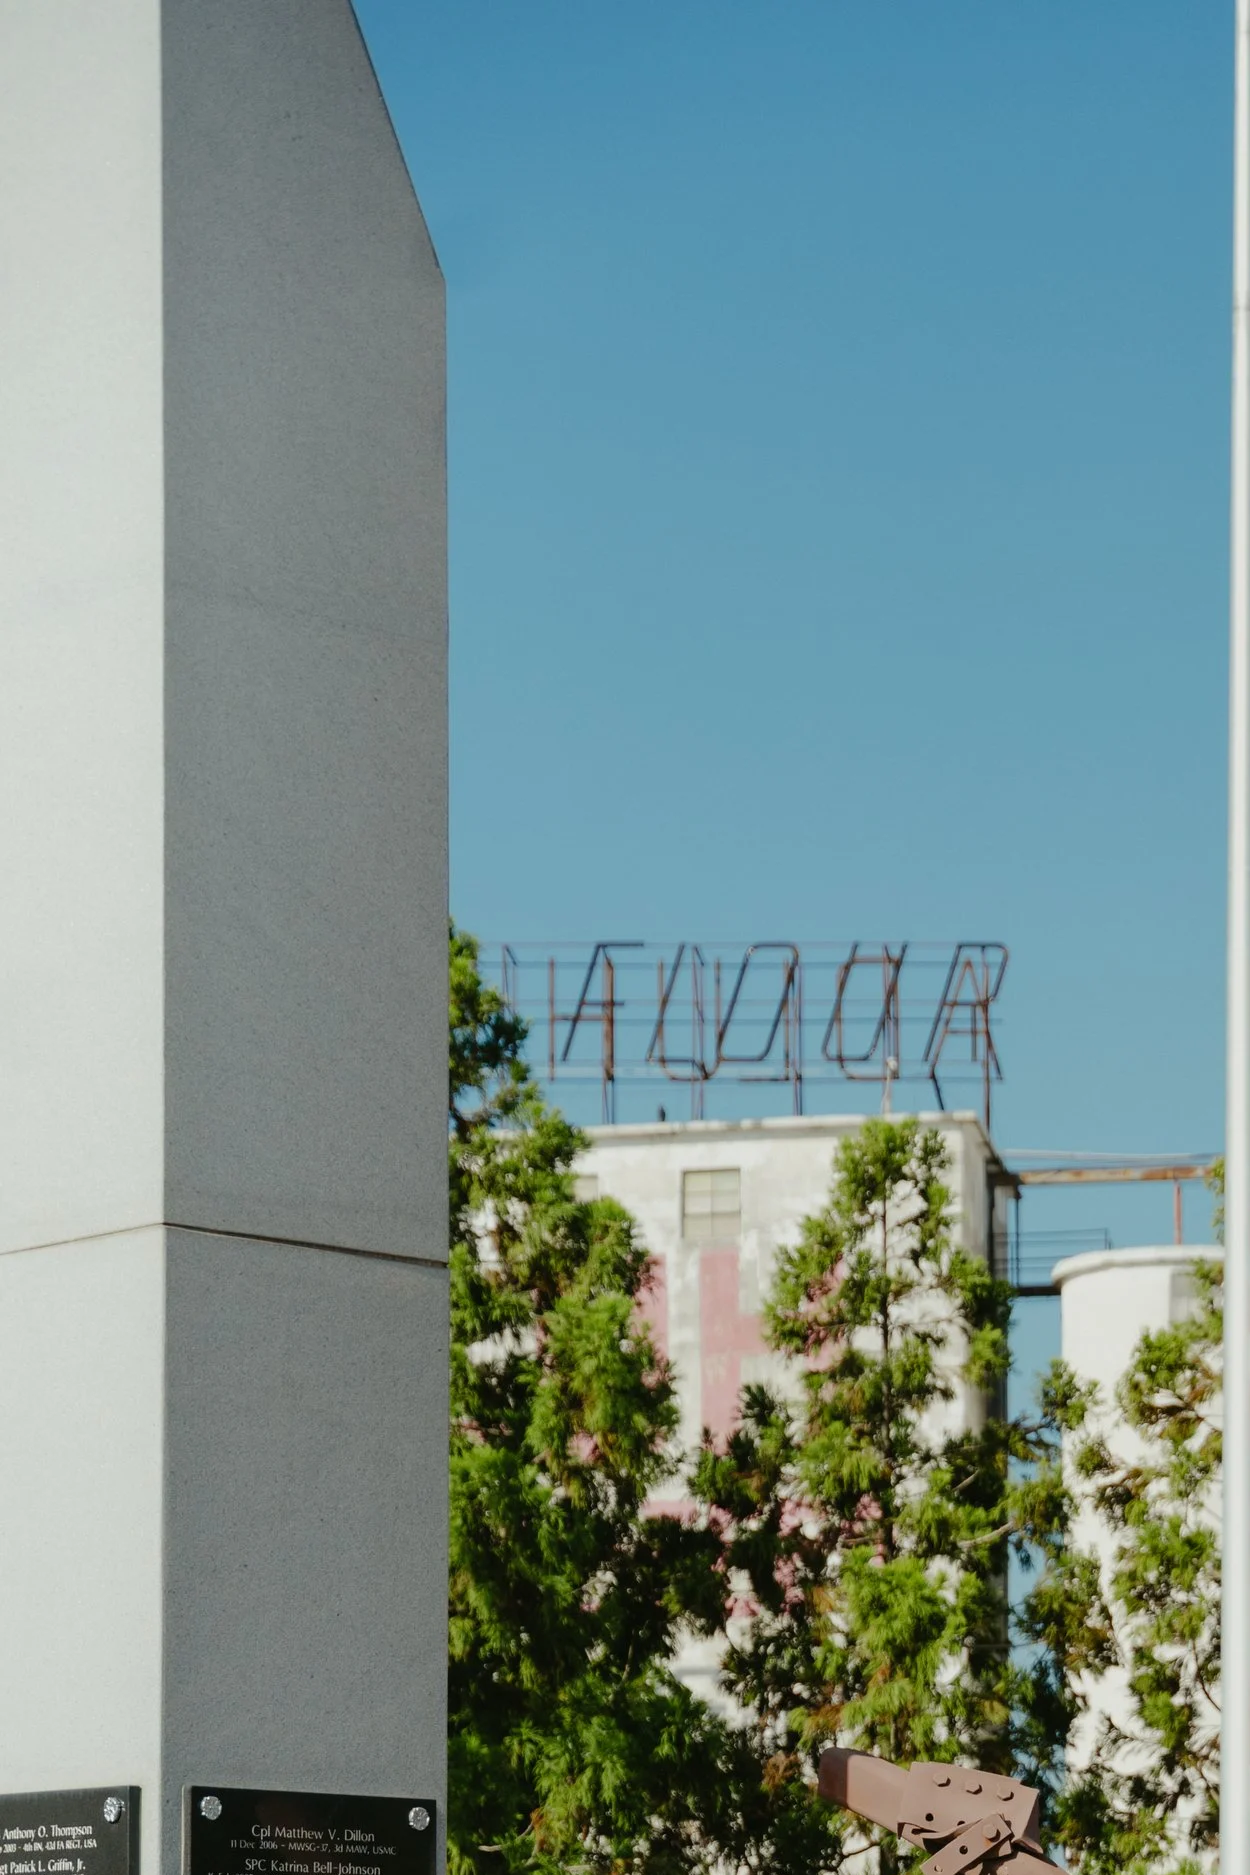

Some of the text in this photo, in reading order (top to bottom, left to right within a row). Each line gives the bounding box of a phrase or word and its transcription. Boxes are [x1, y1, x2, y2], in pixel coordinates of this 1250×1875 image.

[2, 1826, 36, 1842] Anthony
[50, 1824, 92, 1839] Thompson
[251, 1825, 374, 1841] Cpl Matthew V. Dillon
